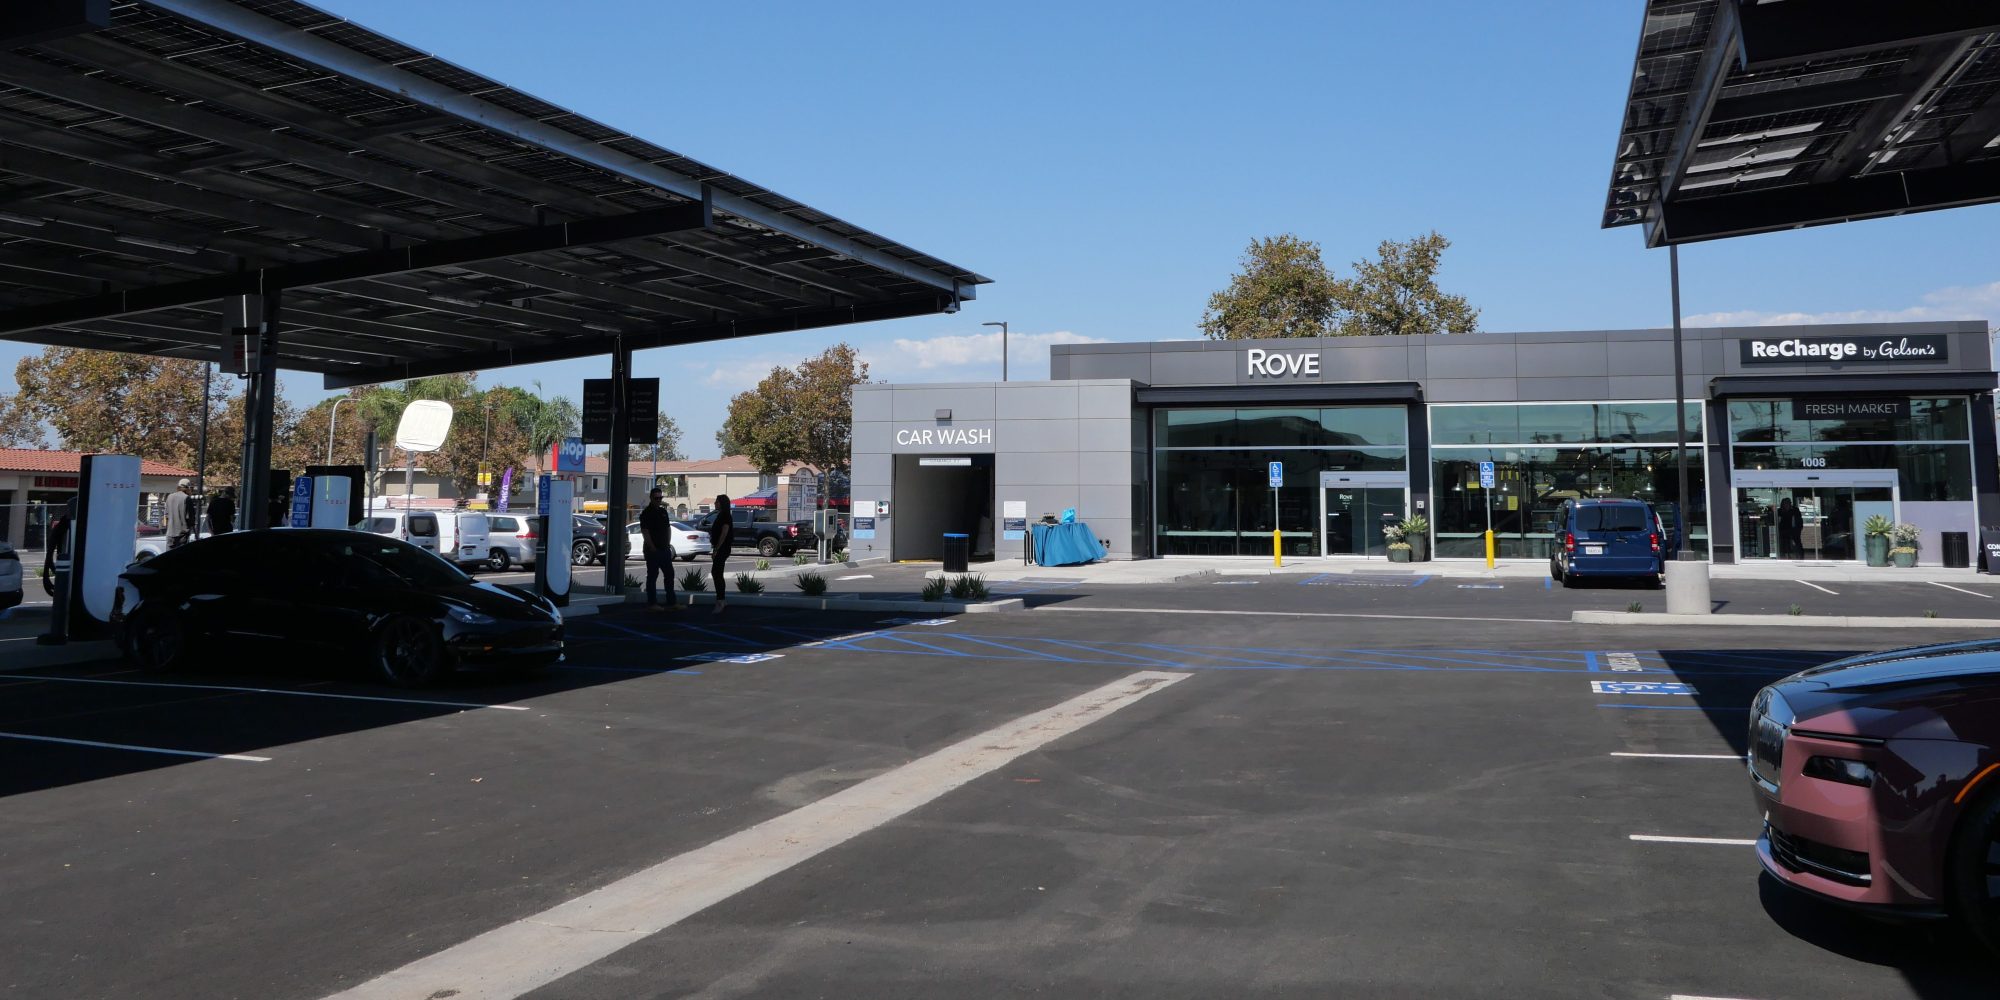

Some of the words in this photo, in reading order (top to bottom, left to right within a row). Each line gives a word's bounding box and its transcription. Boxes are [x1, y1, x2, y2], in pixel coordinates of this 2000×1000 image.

[1751, 339, 1857, 360] ReCharge
[1863, 347, 1876, 359] by
[1879, 338, 1936, 359] Gelson's
[1247, 349, 1320, 375] ROVE
[1805, 404, 1844, 414] FRESH
[1848, 403, 1900, 414] MARKET
[896, 429, 933, 445] CAR
[937, 428, 991, 445] WASH
[1800, 458, 1826, 467] 1008
